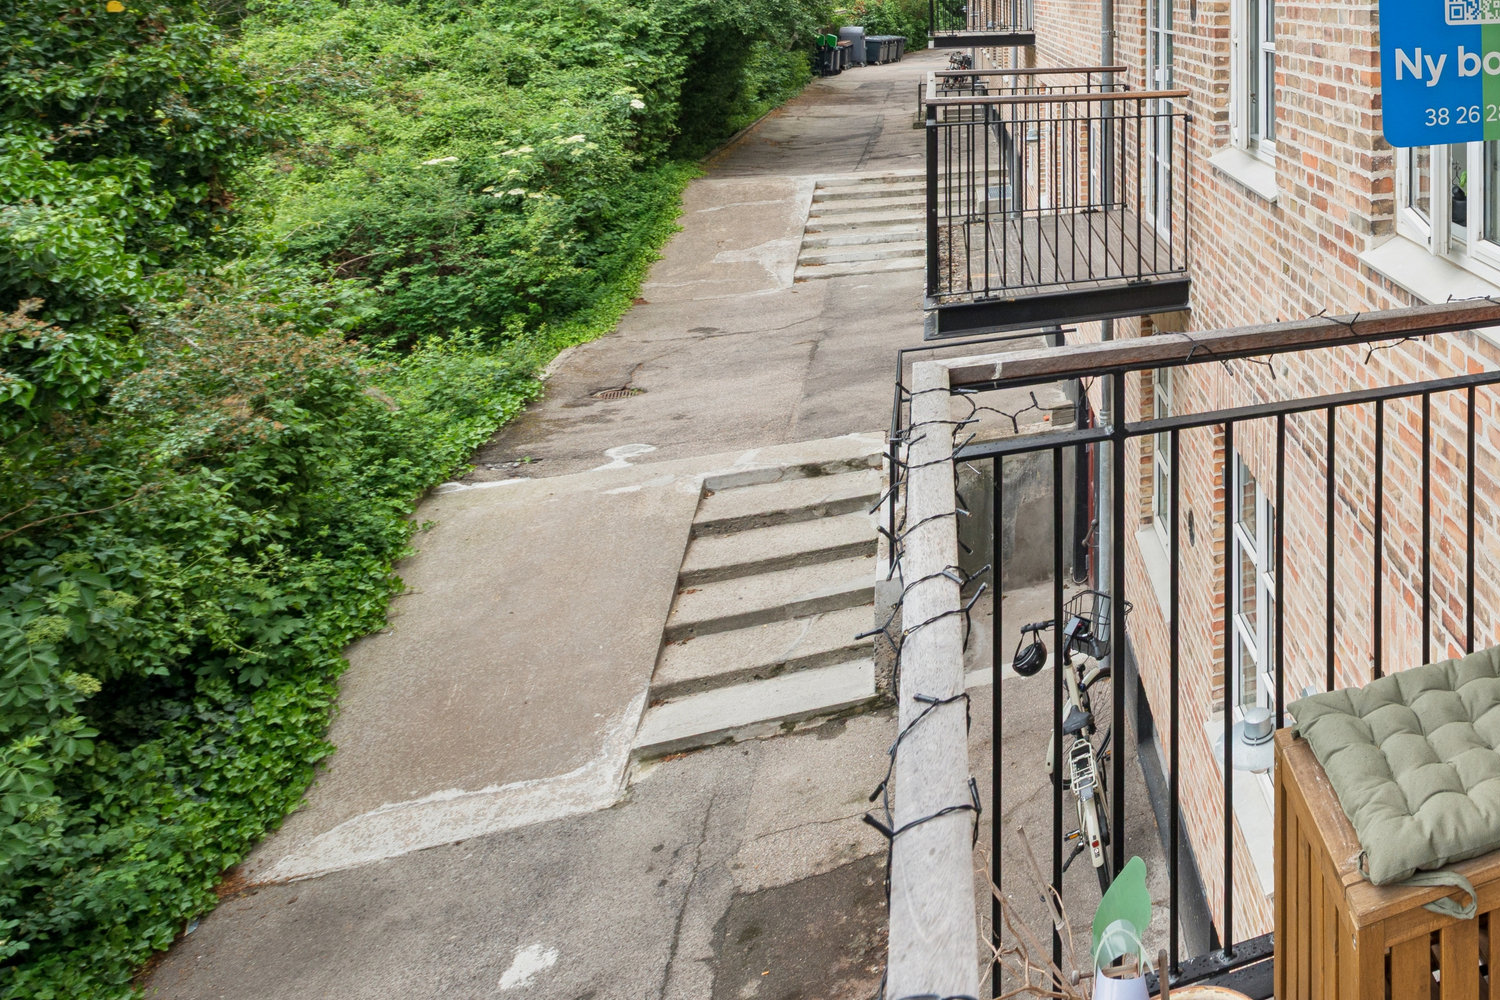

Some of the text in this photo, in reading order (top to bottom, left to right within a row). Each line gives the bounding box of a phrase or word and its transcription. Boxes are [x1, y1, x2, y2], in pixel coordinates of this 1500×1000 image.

[1395, 47, 1447, 87] Ny
[1425, 107, 1450, 126] 38
[1456, 105, 1480, 124] 26
